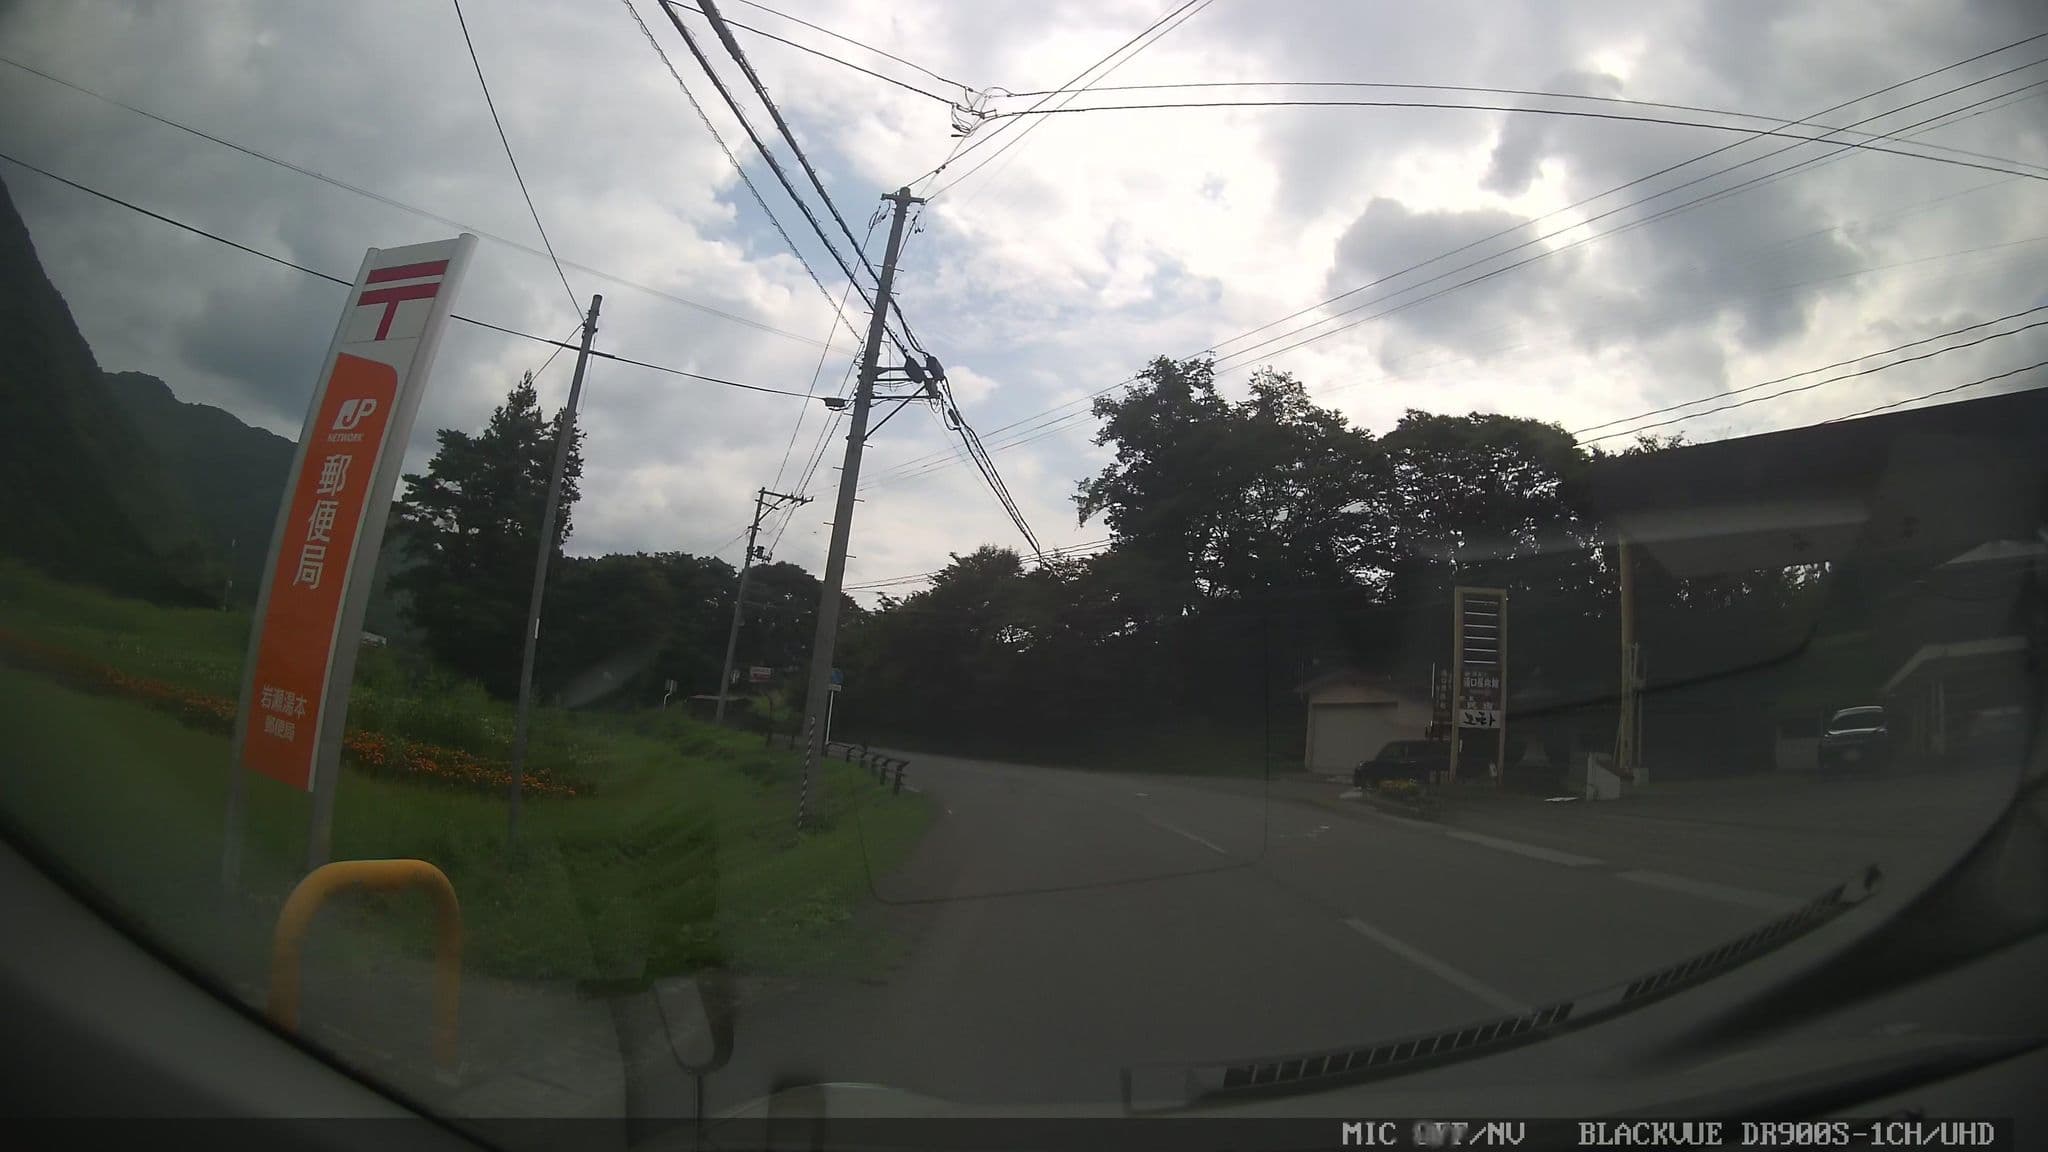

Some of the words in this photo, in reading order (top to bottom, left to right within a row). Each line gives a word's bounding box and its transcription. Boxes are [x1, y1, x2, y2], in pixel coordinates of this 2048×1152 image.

[292, 454, 353, 590] 郵便局
[259, 683, 307, 719] 岩瀬湯本
[263, 714, 296, 742] 郵便局
